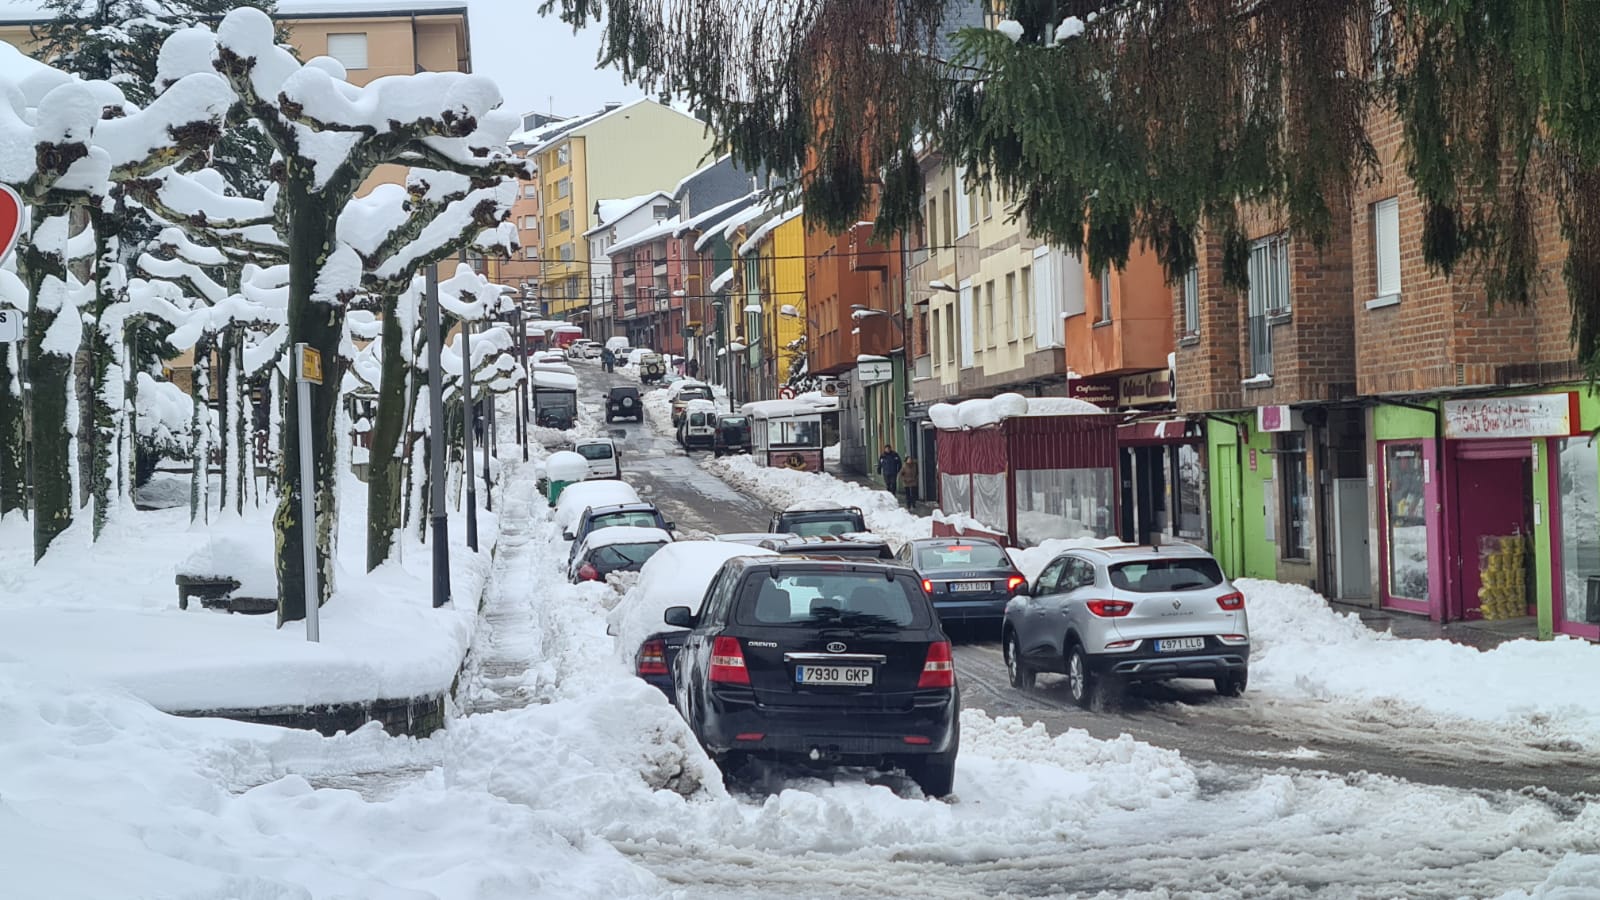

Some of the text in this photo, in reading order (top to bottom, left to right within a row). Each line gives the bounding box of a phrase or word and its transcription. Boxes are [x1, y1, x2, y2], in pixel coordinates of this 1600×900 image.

[1161, 638, 1202, 649] 4971 LLG
[806, 668, 869, 681] 7930 GKP
